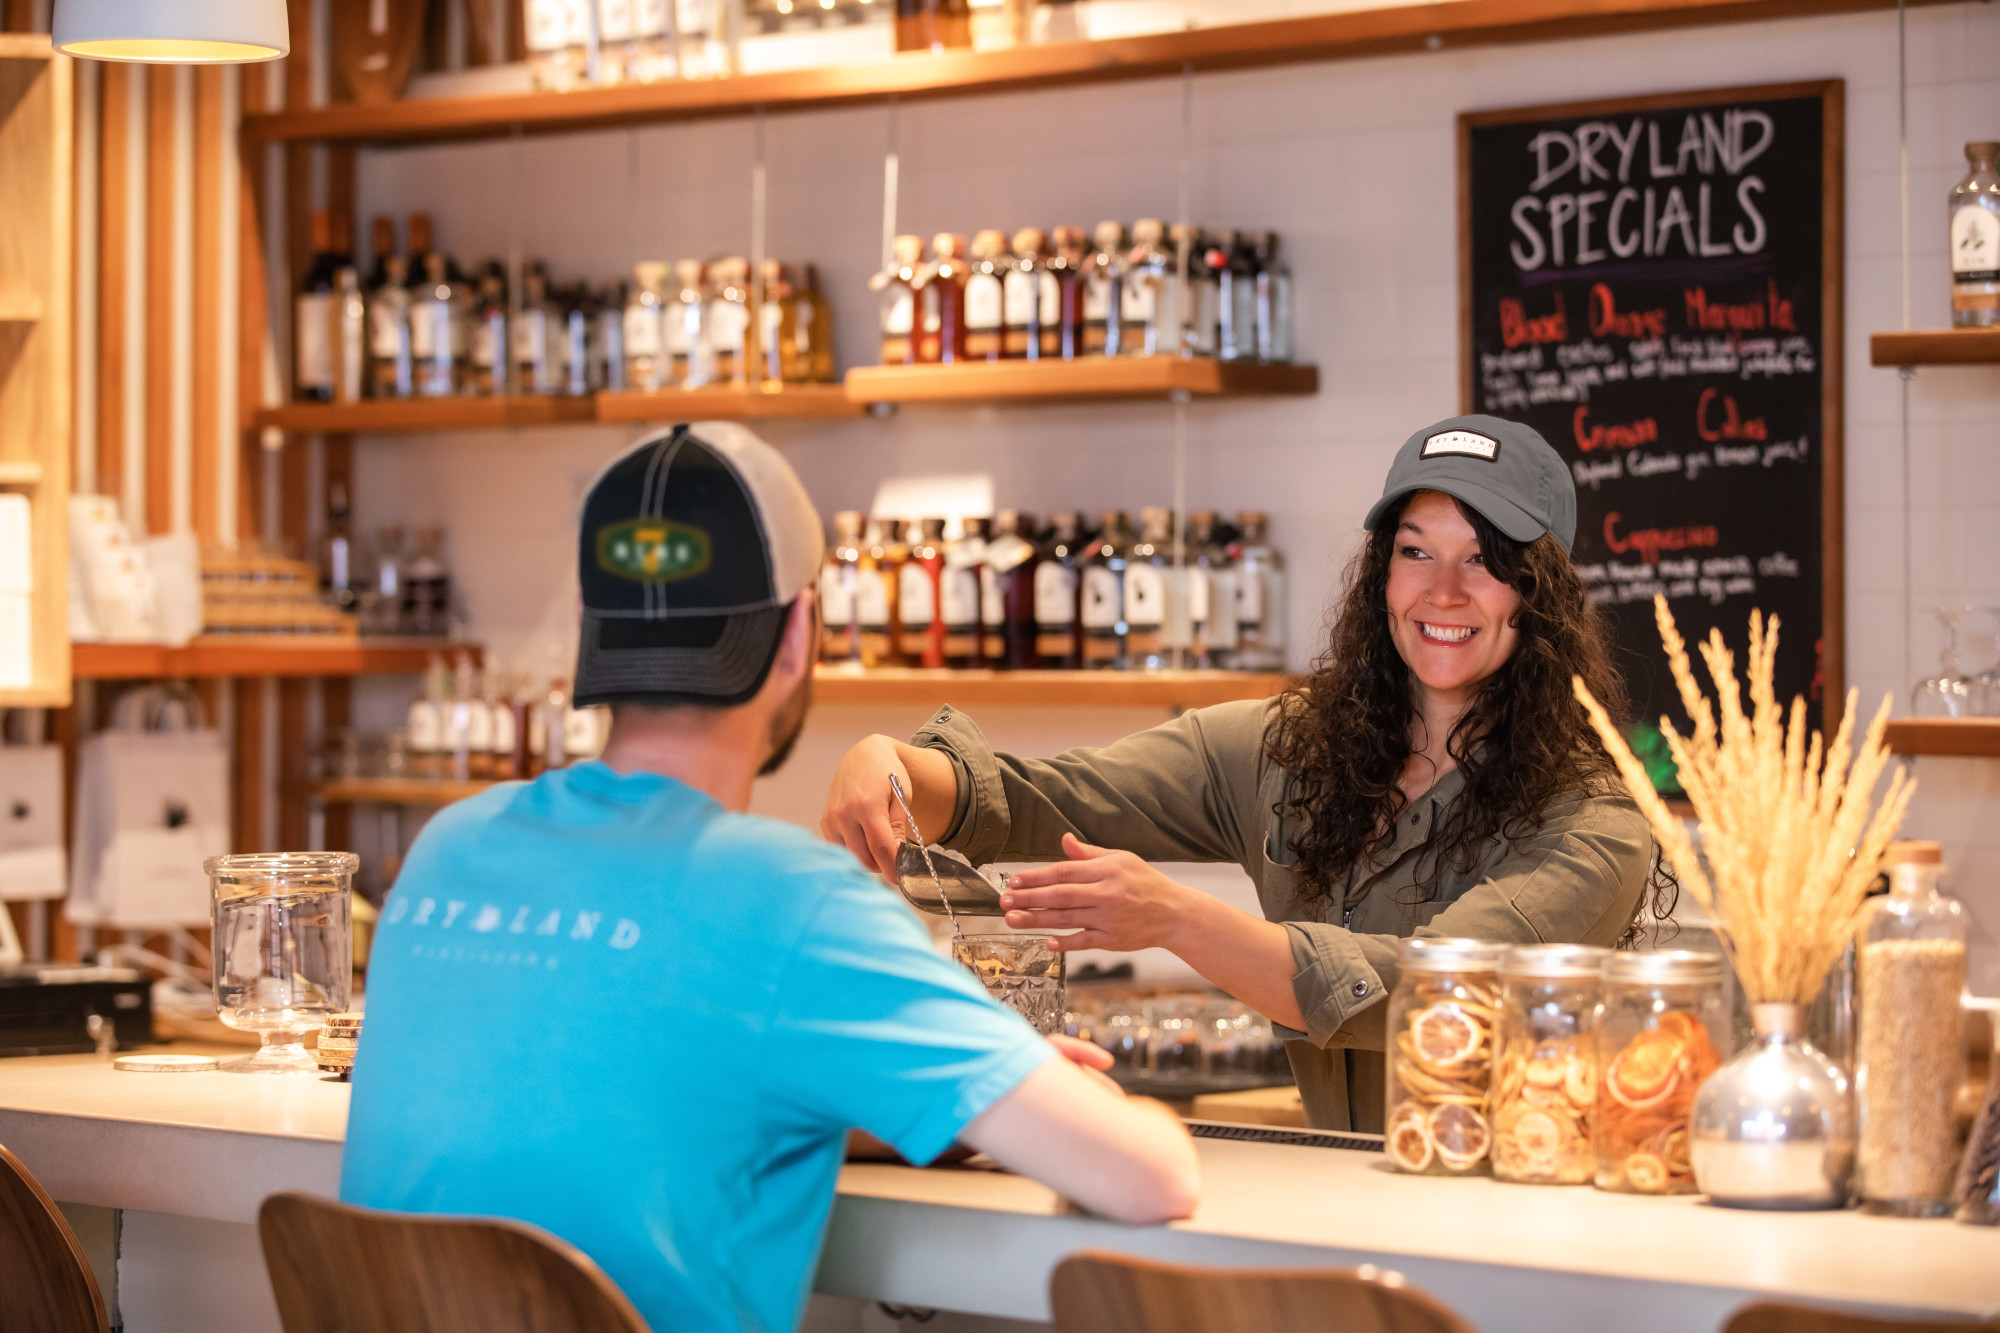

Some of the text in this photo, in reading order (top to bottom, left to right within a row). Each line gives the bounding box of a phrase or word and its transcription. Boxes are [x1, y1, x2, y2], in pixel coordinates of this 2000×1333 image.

[1510, 176, 1766, 271] SPECIALS
[1462, 436, 1494, 449] LAND
[387, 896, 641, 950] DRY LAND
